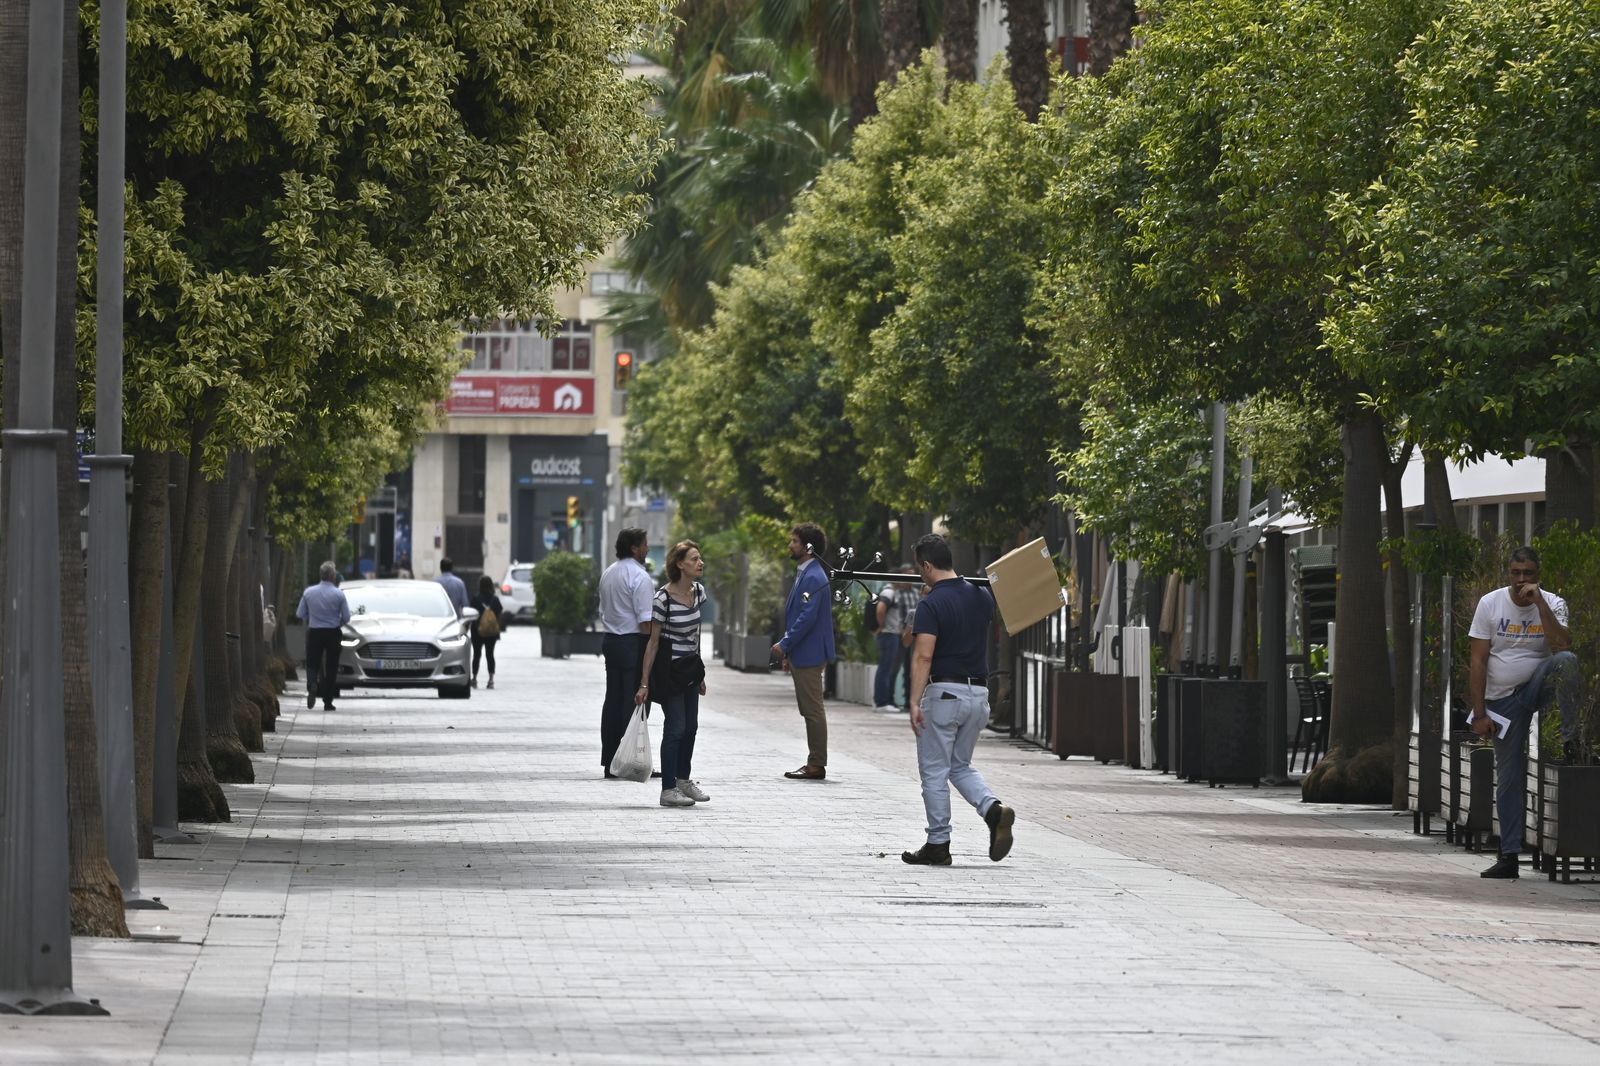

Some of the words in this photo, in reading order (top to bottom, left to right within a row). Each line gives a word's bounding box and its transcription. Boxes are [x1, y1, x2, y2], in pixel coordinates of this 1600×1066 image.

[500, 396, 540, 408] PROPIEDAD
[531, 455, 581, 475] audicost
[1497, 618, 1521, 633] NEW
